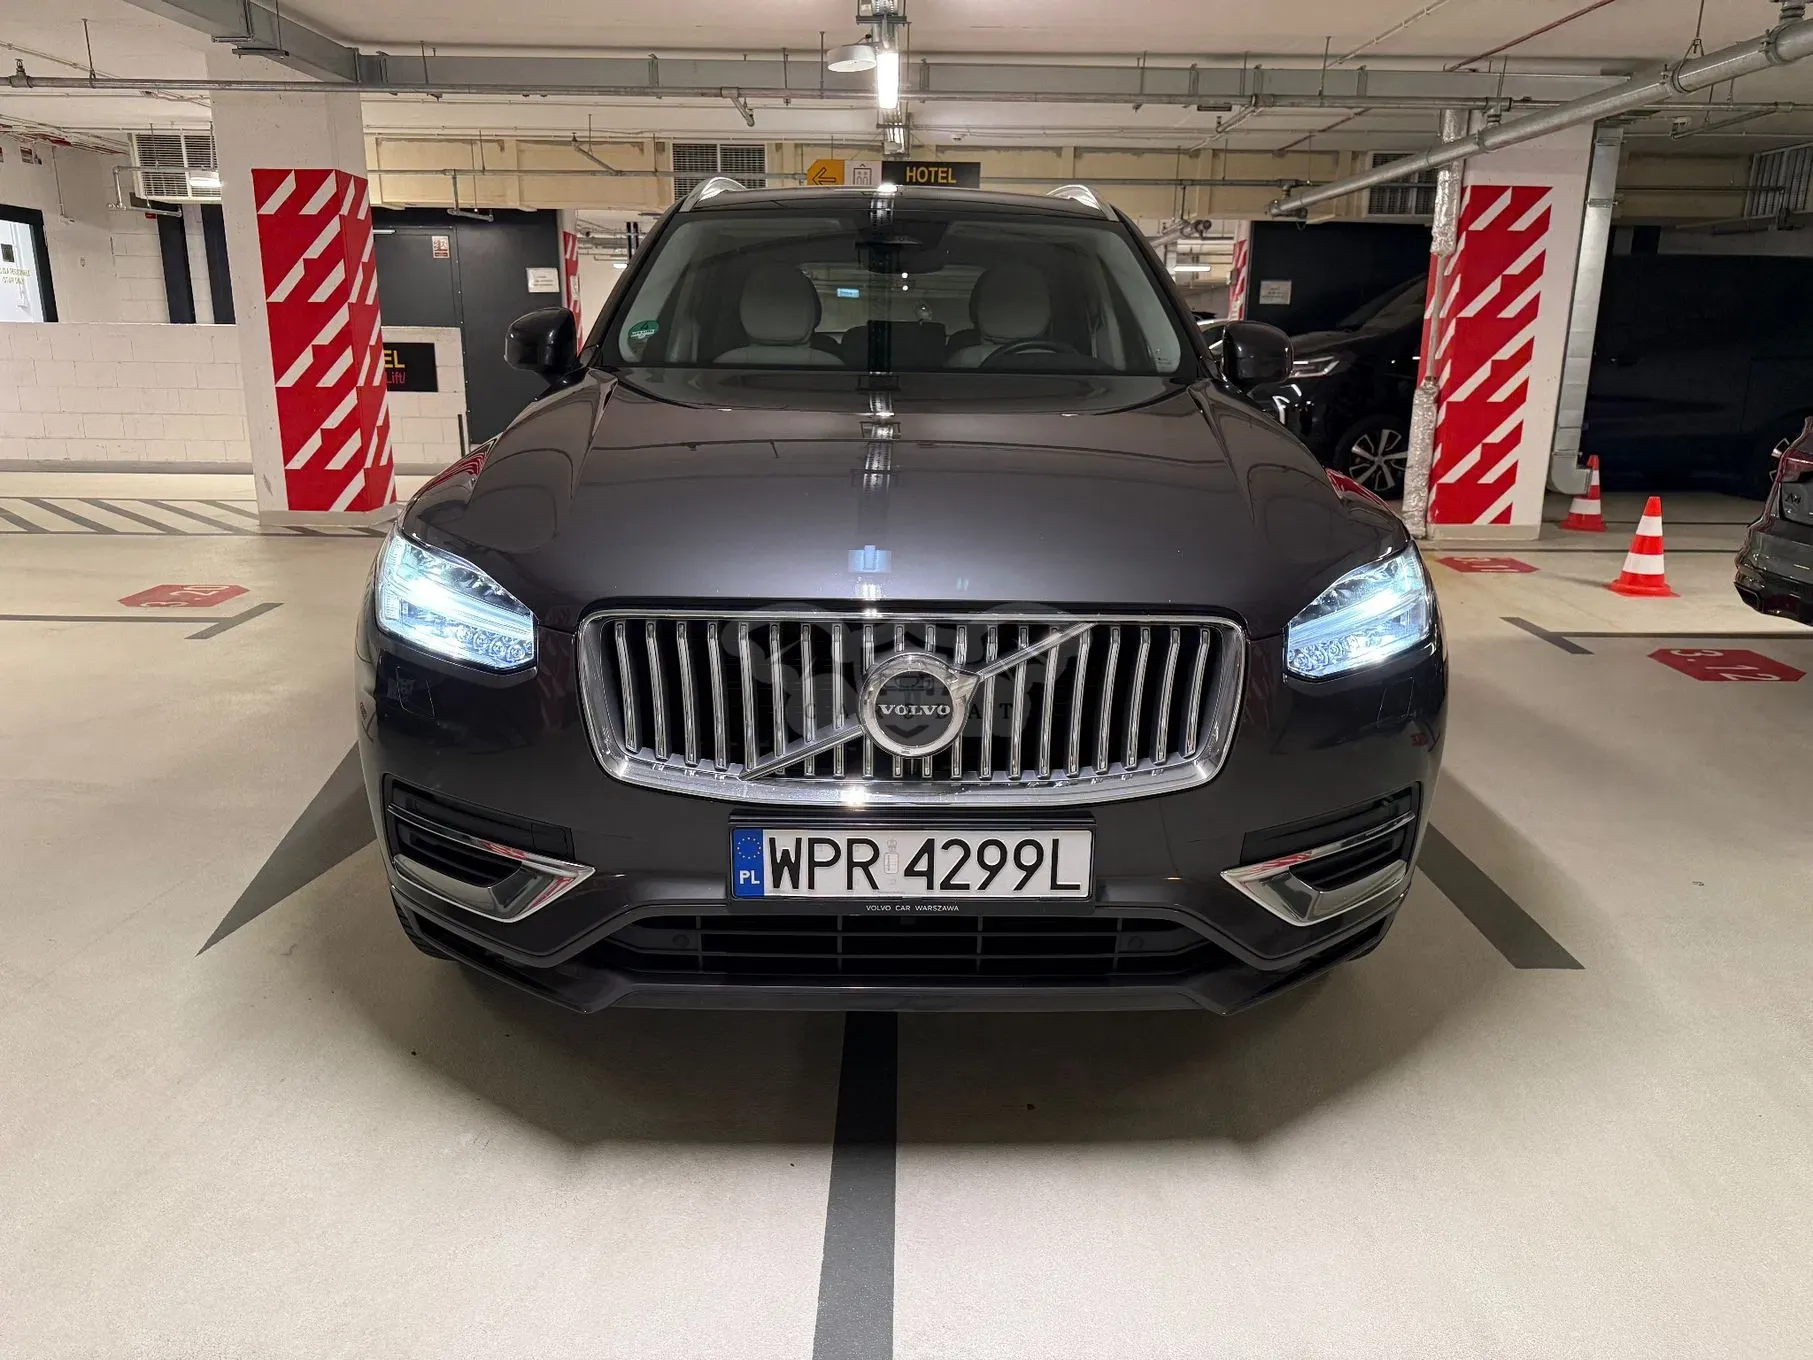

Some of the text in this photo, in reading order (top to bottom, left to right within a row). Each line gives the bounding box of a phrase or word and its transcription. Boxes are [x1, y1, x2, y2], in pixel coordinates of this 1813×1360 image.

[906, 166, 957, 184] HOTEL
[1670, 649, 1781, 681] 3.12
[878, 704, 951, 716] VOLVO
[769, 837, 1080, 891] WPR 4299L
[739, 870, 760, 884] PL
